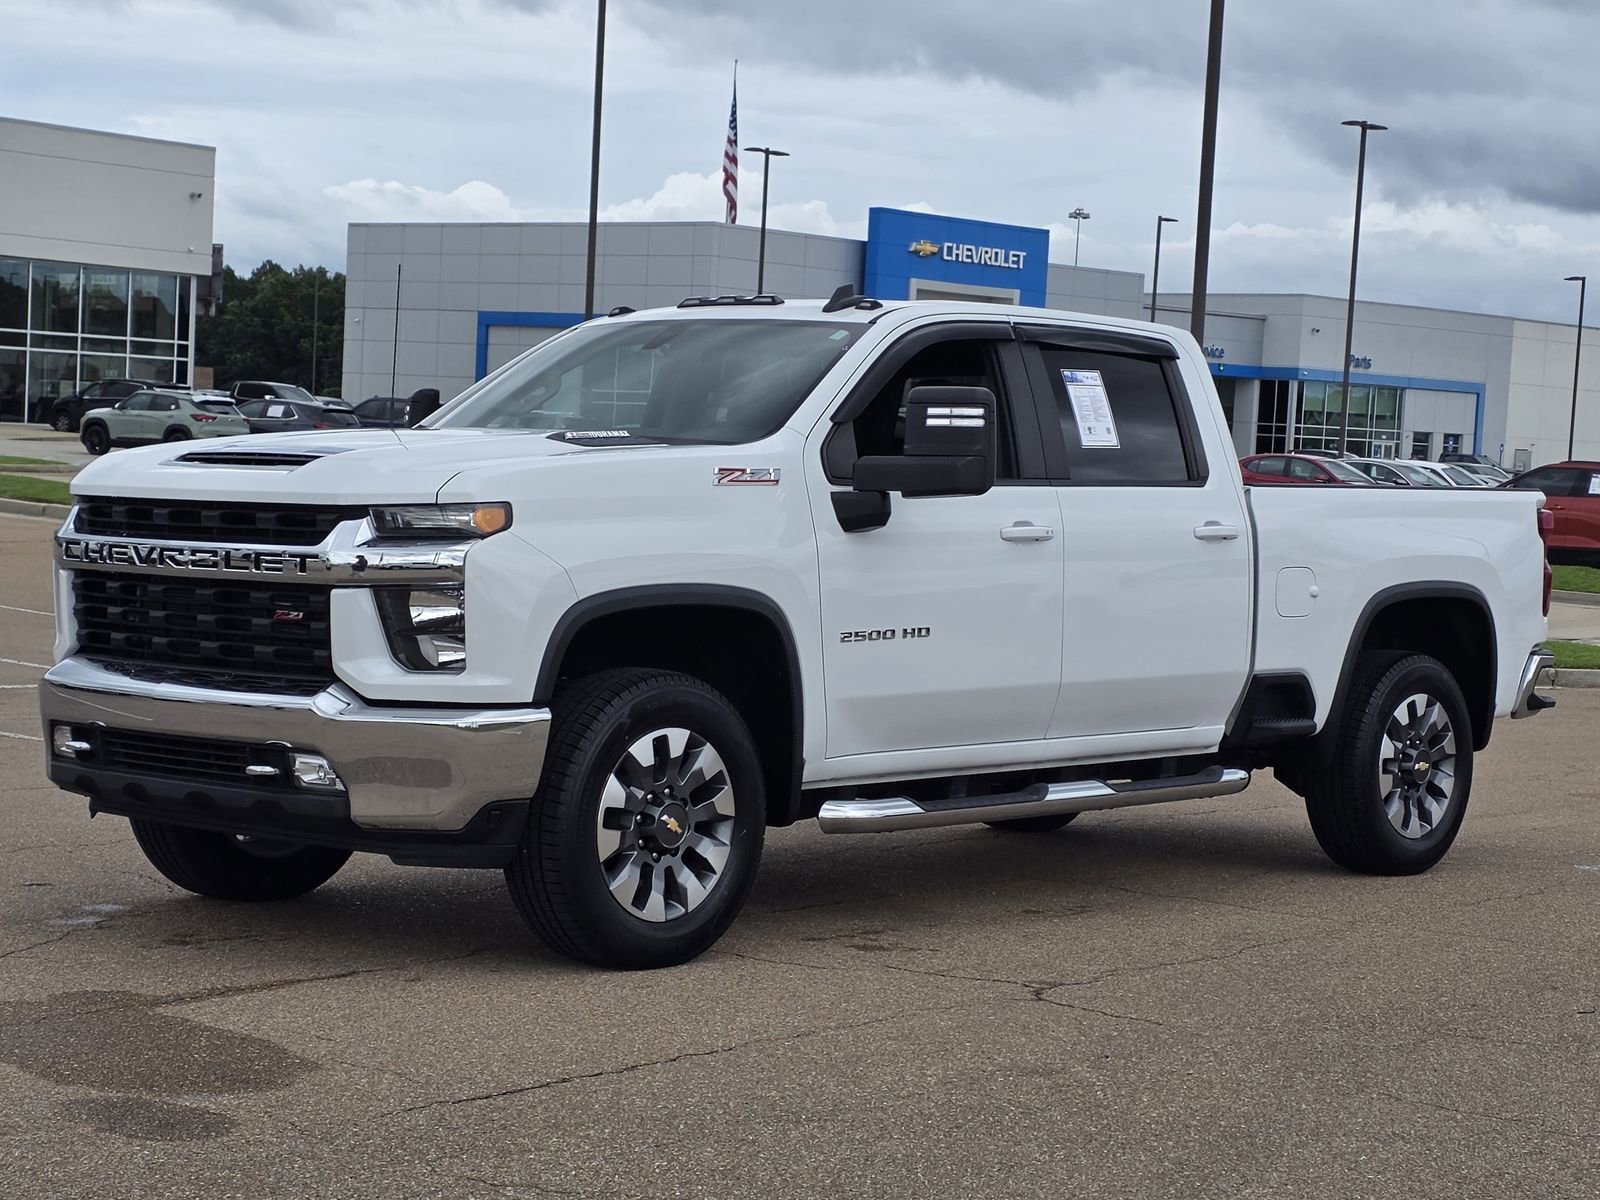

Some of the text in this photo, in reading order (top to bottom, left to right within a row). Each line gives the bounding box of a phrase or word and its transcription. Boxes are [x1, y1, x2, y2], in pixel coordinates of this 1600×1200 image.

[943, 242, 1027, 269] CHEVROLET
[589, 430, 631, 438] DURAMAX
[713, 467, 781, 486] Z71
[63, 541, 320, 576] CHEVROLET
[840, 627, 931, 643] 2500 HD
